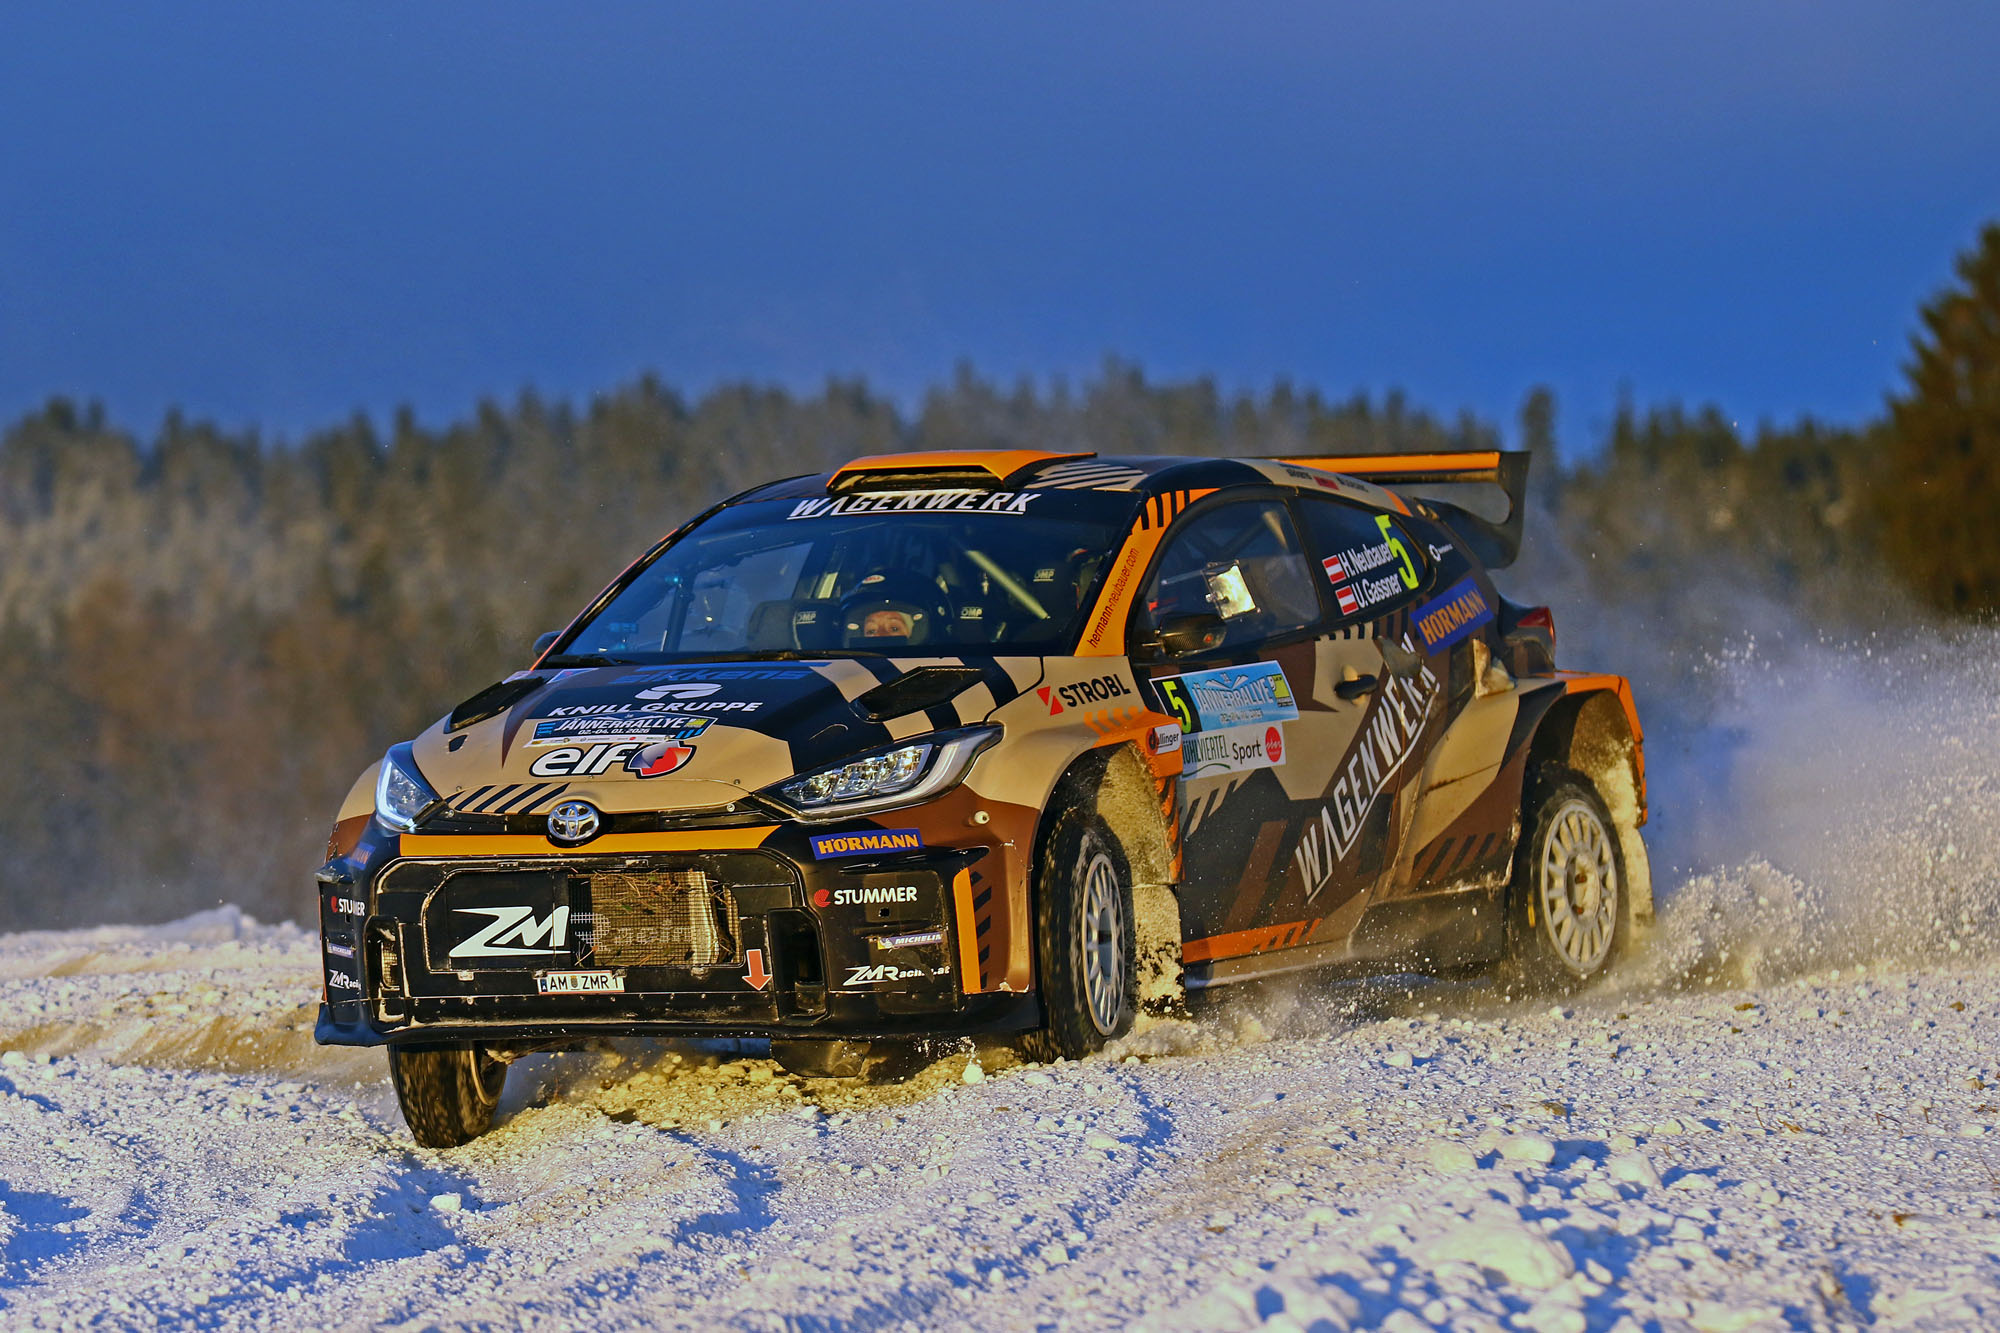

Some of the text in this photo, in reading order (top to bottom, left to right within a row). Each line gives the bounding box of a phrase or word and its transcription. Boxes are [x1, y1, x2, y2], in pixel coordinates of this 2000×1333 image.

[787, 492, 1041, 519] WAGENWERK
[1375, 514, 1419, 589] 5
[1086, 547, 1140, 649] hermann-neubauer.com
[1058, 674, 1131, 707] STROBL
[547, 703, 634, 717] KNILL
[640, 702, 763, 713] GRUPPE
[1162, 680, 1192, 733] 5
[553, 717, 691, 731] JÄNNERRALLYE
[531, 744, 640, 777] elf
[1232, 740, 1263, 764] Sport
[818, 834, 920, 854] HÖRMANN
[834, 886, 918, 905] STUMMER
[895, 934, 943, 945] MICHELIN
[550, 976, 568, 990] AM
[581, 975, 610, 990] ZMR
